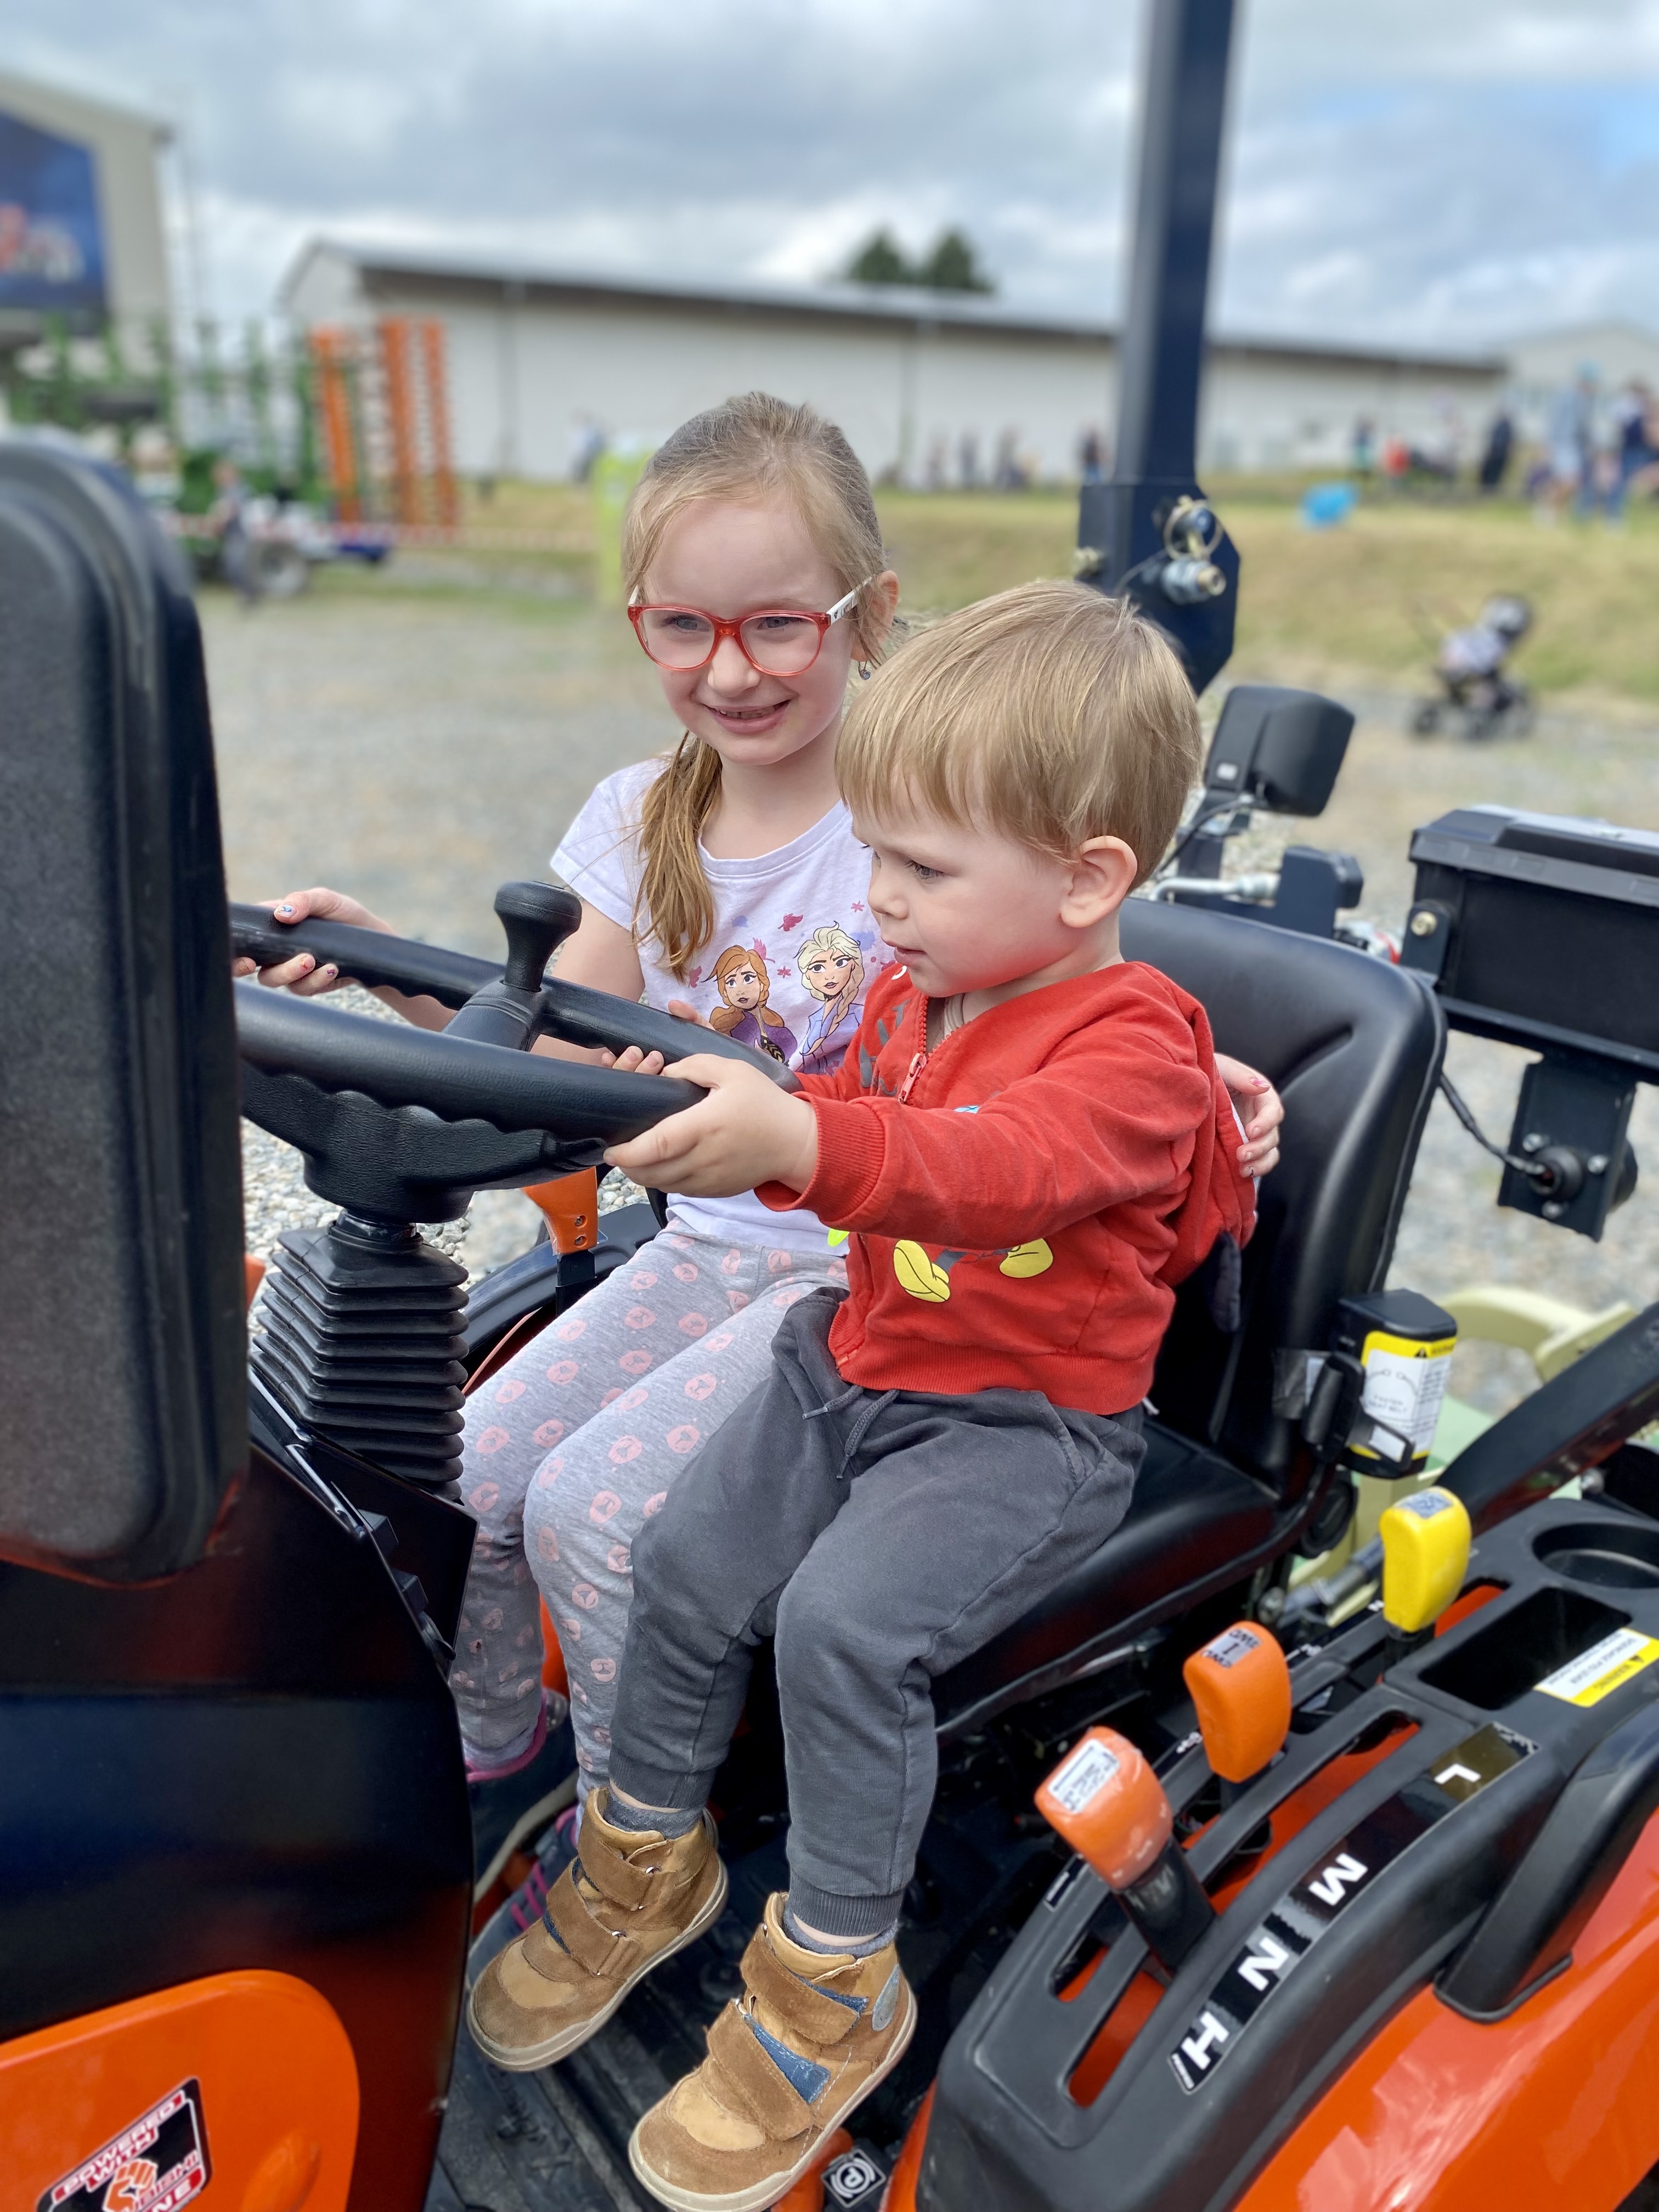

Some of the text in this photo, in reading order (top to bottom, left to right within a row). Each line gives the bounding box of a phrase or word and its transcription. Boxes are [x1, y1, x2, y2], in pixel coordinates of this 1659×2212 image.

[1435, 1763, 1481, 1784] L
[1308, 1853, 1368, 1906] M
[1238, 1937, 1289, 1991] N
[1181, 2011, 1229, 2070] H
[64, 2101, 174, 2194] POWERED
[94, 2130, 152, 2182] WITH
[844, 2166, 864, 2189] P
